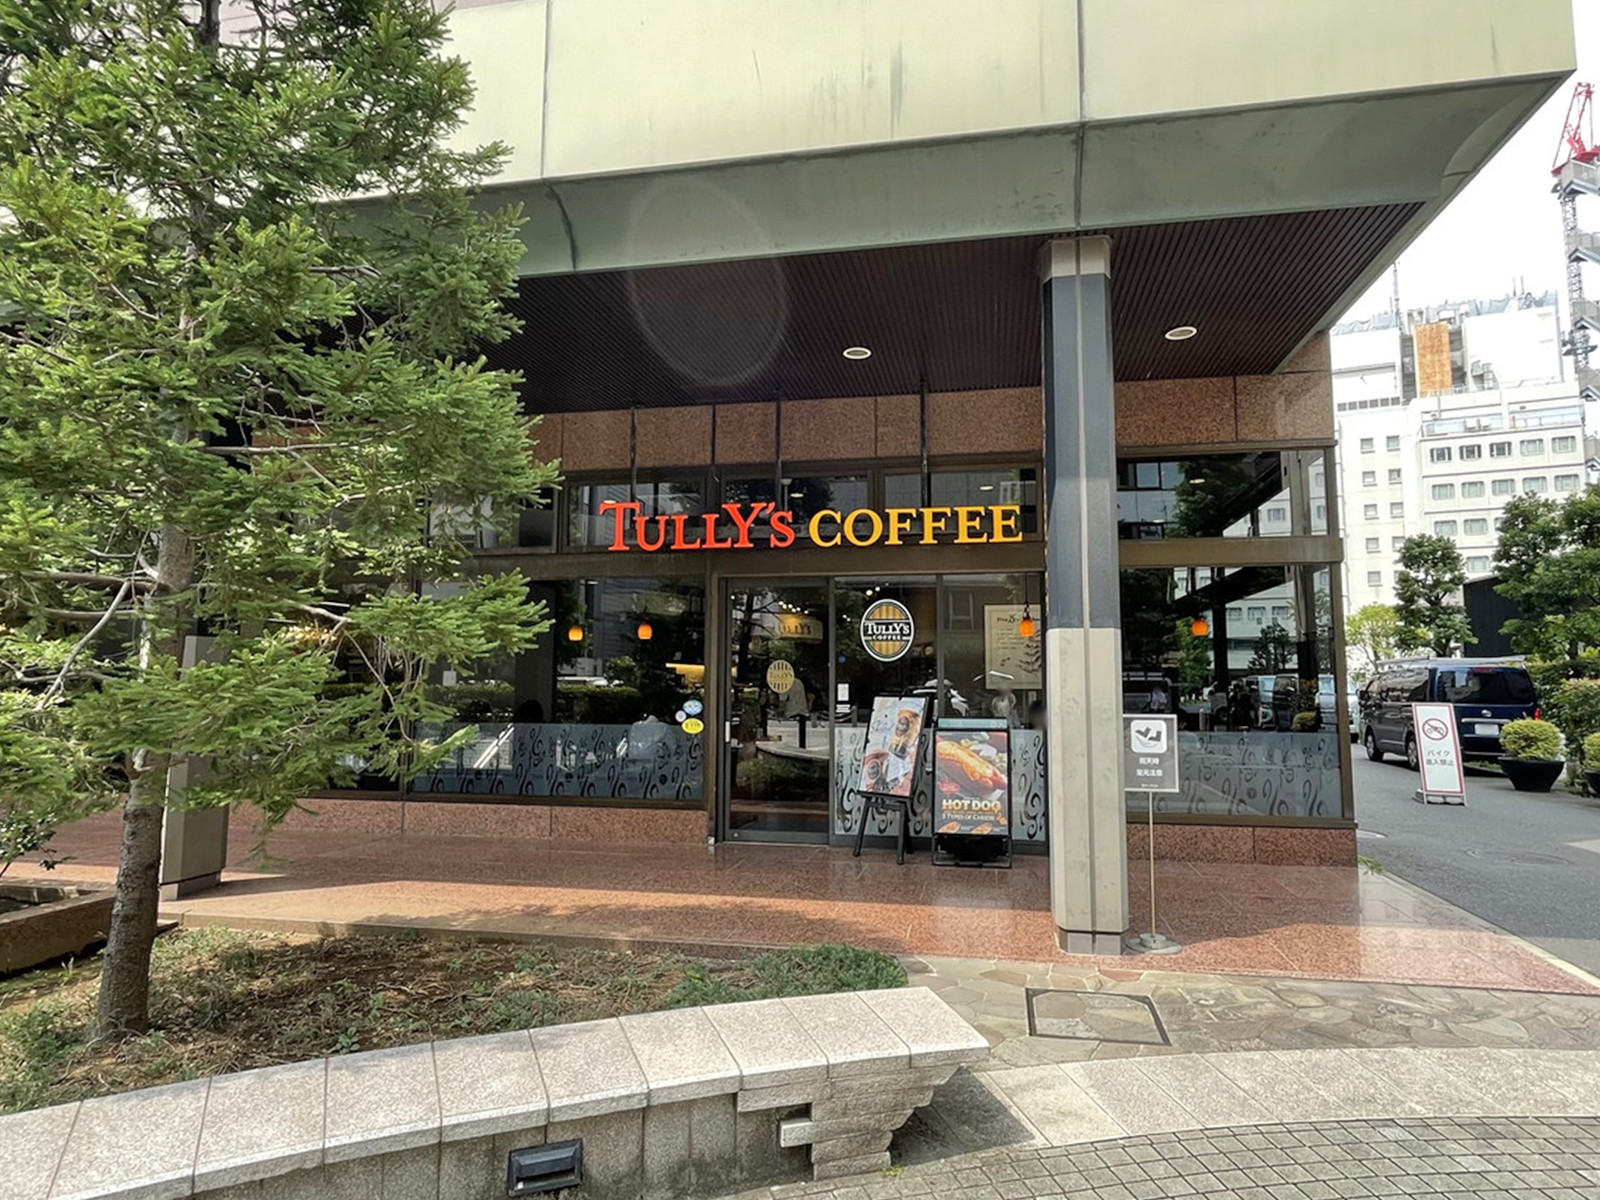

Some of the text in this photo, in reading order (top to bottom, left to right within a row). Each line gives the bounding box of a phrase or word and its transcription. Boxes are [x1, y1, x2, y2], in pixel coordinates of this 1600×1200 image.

[599, 501, 1023, 552] TULLY'S COFFEE
[864, 622, 910, 635] TULLY'S
[942, 799, 1002, 812] HOT DOG
